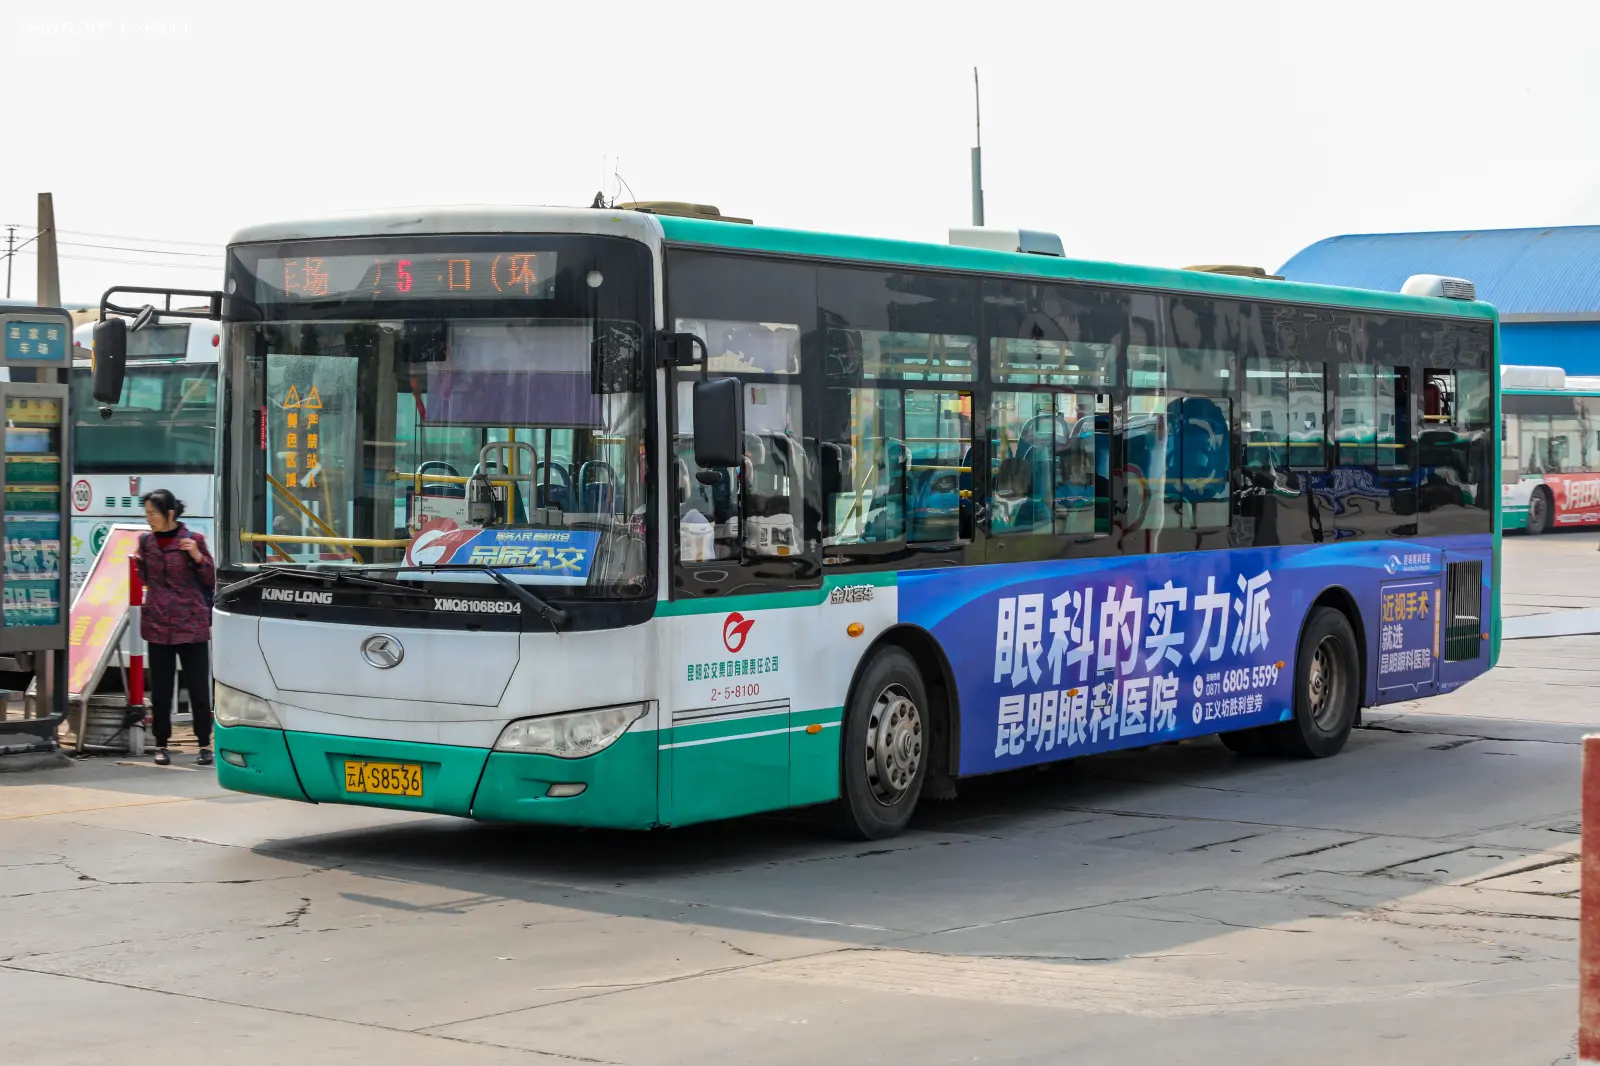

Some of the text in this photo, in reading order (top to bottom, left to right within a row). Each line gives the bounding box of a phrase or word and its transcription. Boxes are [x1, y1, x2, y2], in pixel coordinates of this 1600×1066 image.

[305, 413, 320, 488] 严禁站人
[467, 545, 587, 572] 品质公交
[261, 587, 333, 604] KING LONG
[433, 598, 522, 615] XMQ6106BGD4
[830, 584, 875, 605] 金龙客车
[1382, 590, 1429, 622] 近视手术
[993, 569, 1273, 688] 眼科的实力派
[1381, 623, 1404, 651] 就选
[687, 655, 780, 682] 昆明公交集团有限责任公司
[1380, 648, 1431, 675] 昆明眼科医院
[1205, 663, 1279, 696] 0871 6805 5599
[994, 671, 1180, 759] 昆明眼科医院
[1204, 693, 1263, 721] 正义坊胜利堂旁
